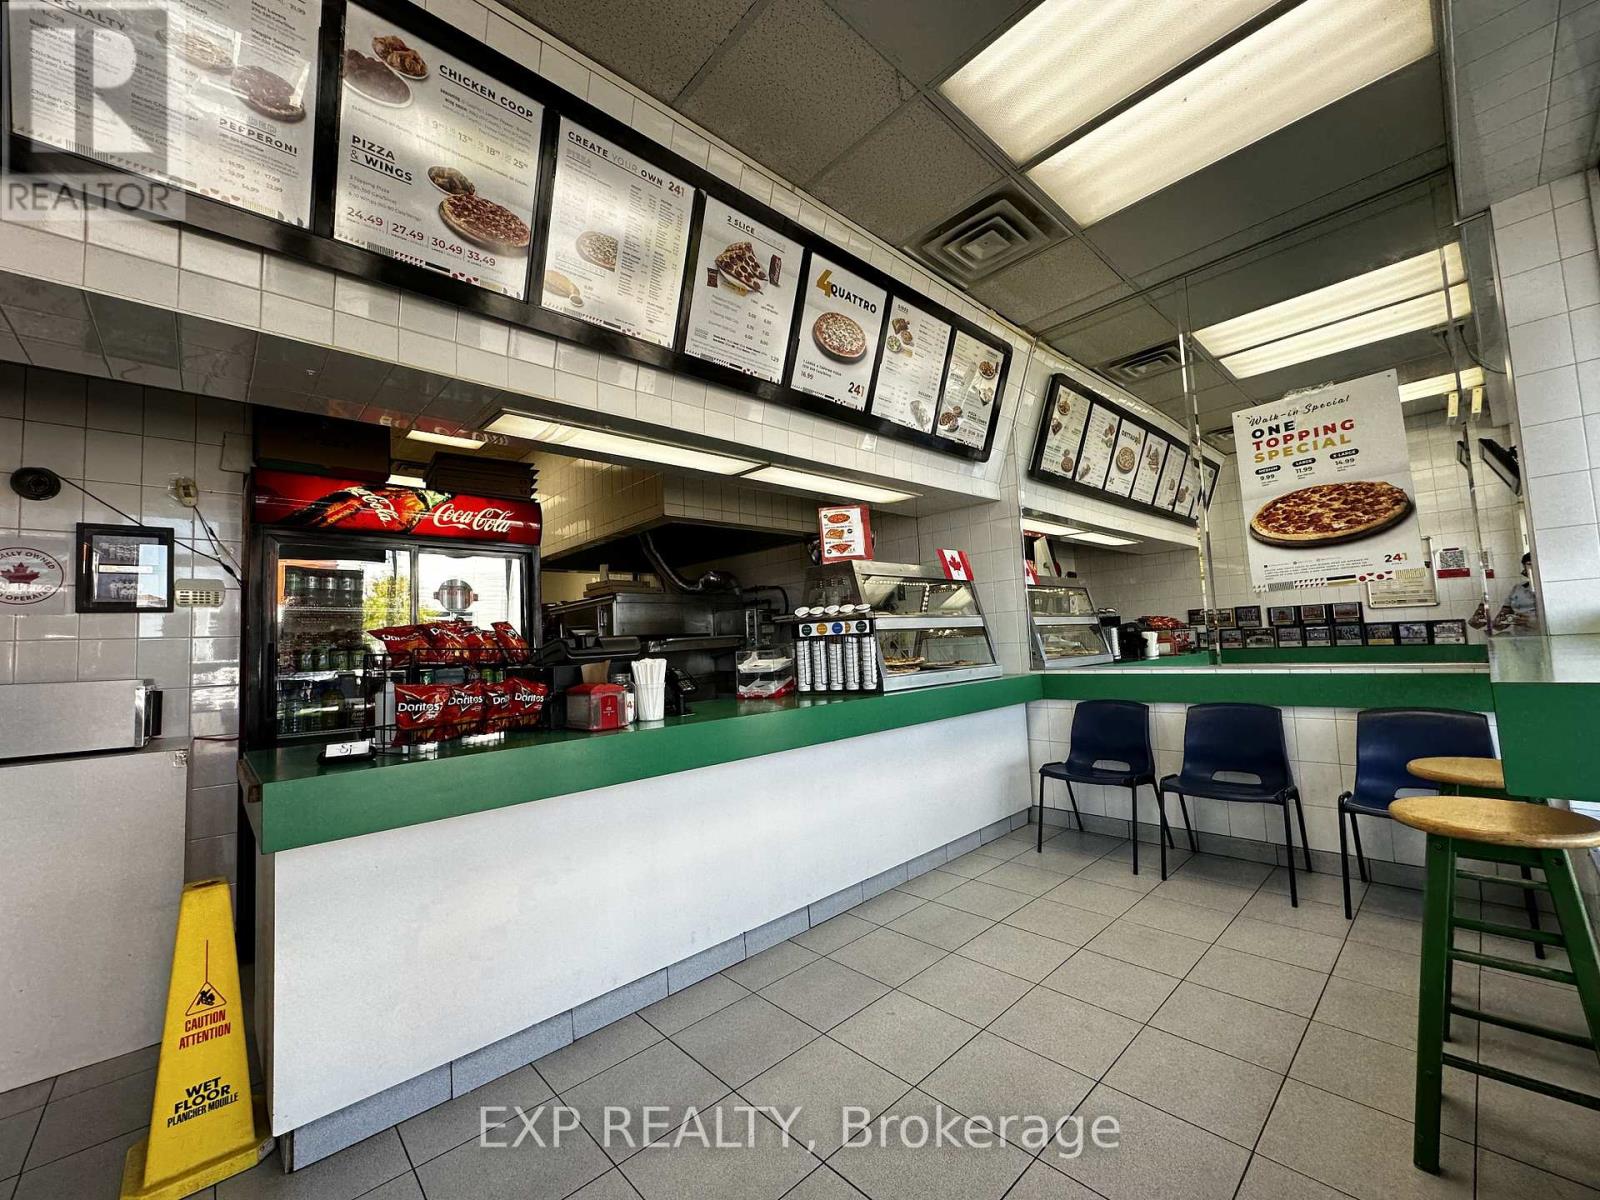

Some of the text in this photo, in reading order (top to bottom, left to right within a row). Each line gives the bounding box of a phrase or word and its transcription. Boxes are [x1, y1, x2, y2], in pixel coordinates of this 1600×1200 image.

[440, 65, 533, 117] CHICKEN COOP
[220, 118, 298, 154] PEPPERONI
[352, 135, 395, 160] PIZZA
[350, 149, 412, 181] & WINGS
[568, 131, 685, 197] CREATE YOUR OWN 241
[347, 206, 383, 226] 24.49
[392, 223, 424, 241] 27.49
[431, 236, 463, 255] 30.49
[467, 249, 496, 267] 33.49
[727, 215, 755, 235] 2 SLICE
[816, 269, 877, 314] 4 QUATTRO
[848, 382, 865, 398] 241
[1246, 395, 1350, 427] Walk-in Special
[1251, 420, 1296, 440] ONE
[1252, 419, 1355, 451] TOPPING
[1254, 434, 1352, 464] SPECIAL
[433, 503, 515, 533] Coca-Cola
[25, 551, 55, 570] OWNED
[1384, 552, 1408, 563] 241
[398, 701, 440, 712] Doritos
[448, 694, 483, 705] Doritos
[515, 692, 544, 702] Doritos
[185, 1009, 226, 1033] CAUTION
[179, 1022, 231, 1050] ATTENTION
[174, 1084, 231, 1115] FLOOR
[185, 1077, 221, 1098] WET
[167, 1104, 206, 1128] PLANCHER
